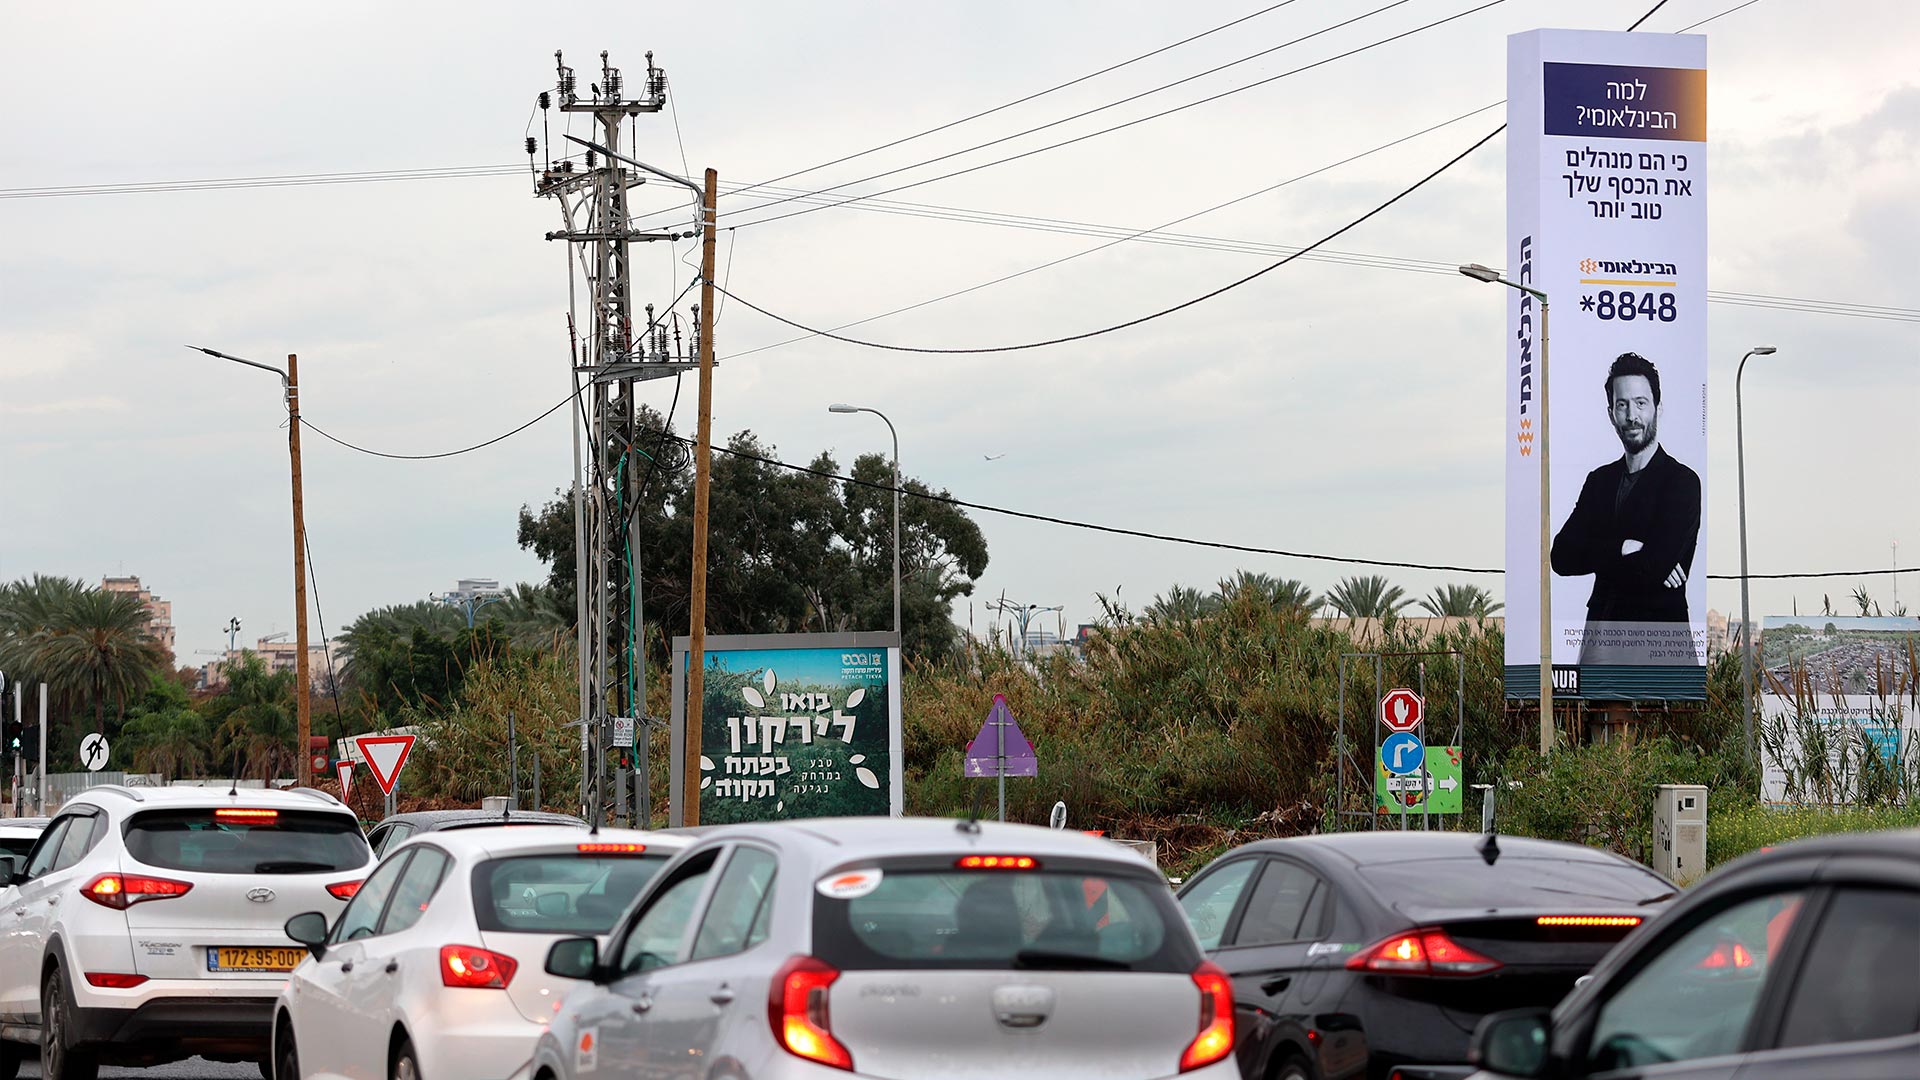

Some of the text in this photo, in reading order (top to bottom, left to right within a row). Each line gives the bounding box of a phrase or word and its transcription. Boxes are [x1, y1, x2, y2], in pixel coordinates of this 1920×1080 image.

[1606, 79, 1647, 101] למה
[1576, 105, 1677, 129] הבינלאומי?
[1566, 146, 1688, 172] כי הם מנהלים
[1562, 171, 1692, 200] את הכסף שלך
[1588, 200, 1662, 220] טוב יותר
[1598, 260, 1677, 275] הבינלאומי
[1552, 670, 1577, 688] NUR
[780, 692, 830, 710] בואו
[727, 709, 856, 753] לירקון
[724, 756, 790, 775] בפתח
[810, 758, 832, 768] טבע
[801, 771, 841, 780] במרחק
[715, 779, 775, 802] תקוה
[793, 784, 829, 794] נגיעה
